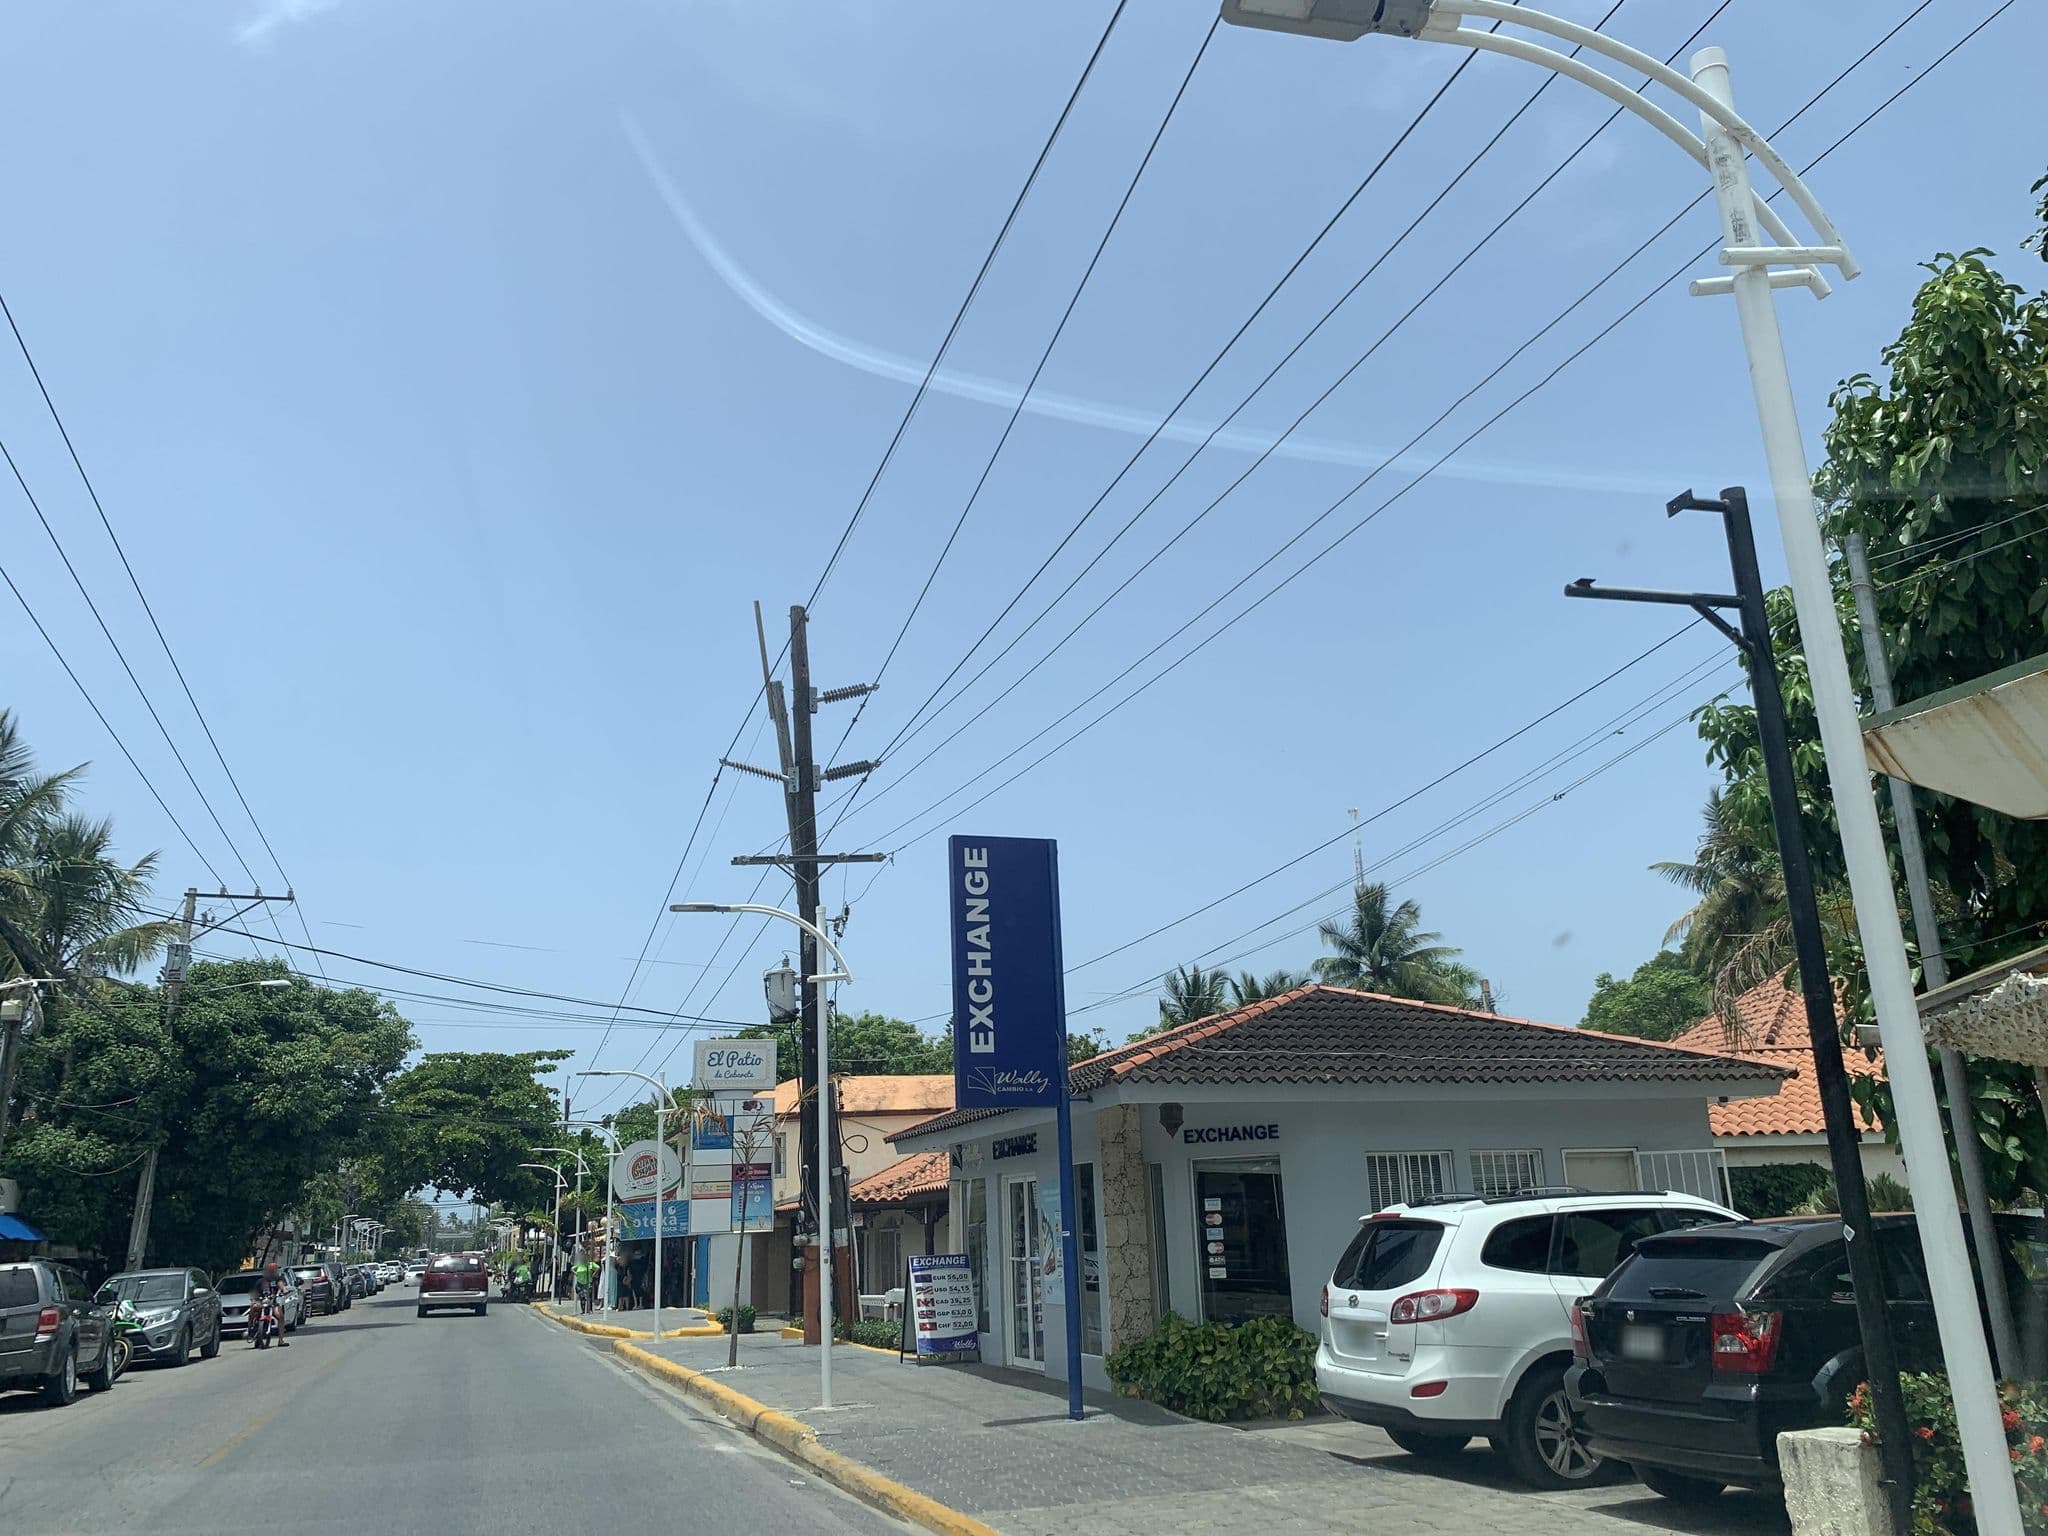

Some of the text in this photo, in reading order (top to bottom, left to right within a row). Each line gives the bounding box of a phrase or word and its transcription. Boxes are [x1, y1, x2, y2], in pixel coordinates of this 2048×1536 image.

[964, 847, 995, 1054] EXCHANGE
[708, 1050, 764, 1068] El Patio
[995, 1069, 1049, 1094] Wally
[1183, 1124, 1280, 1144] EXCHANGE
[913, 1257, 966, 1266] EXCHANGE
